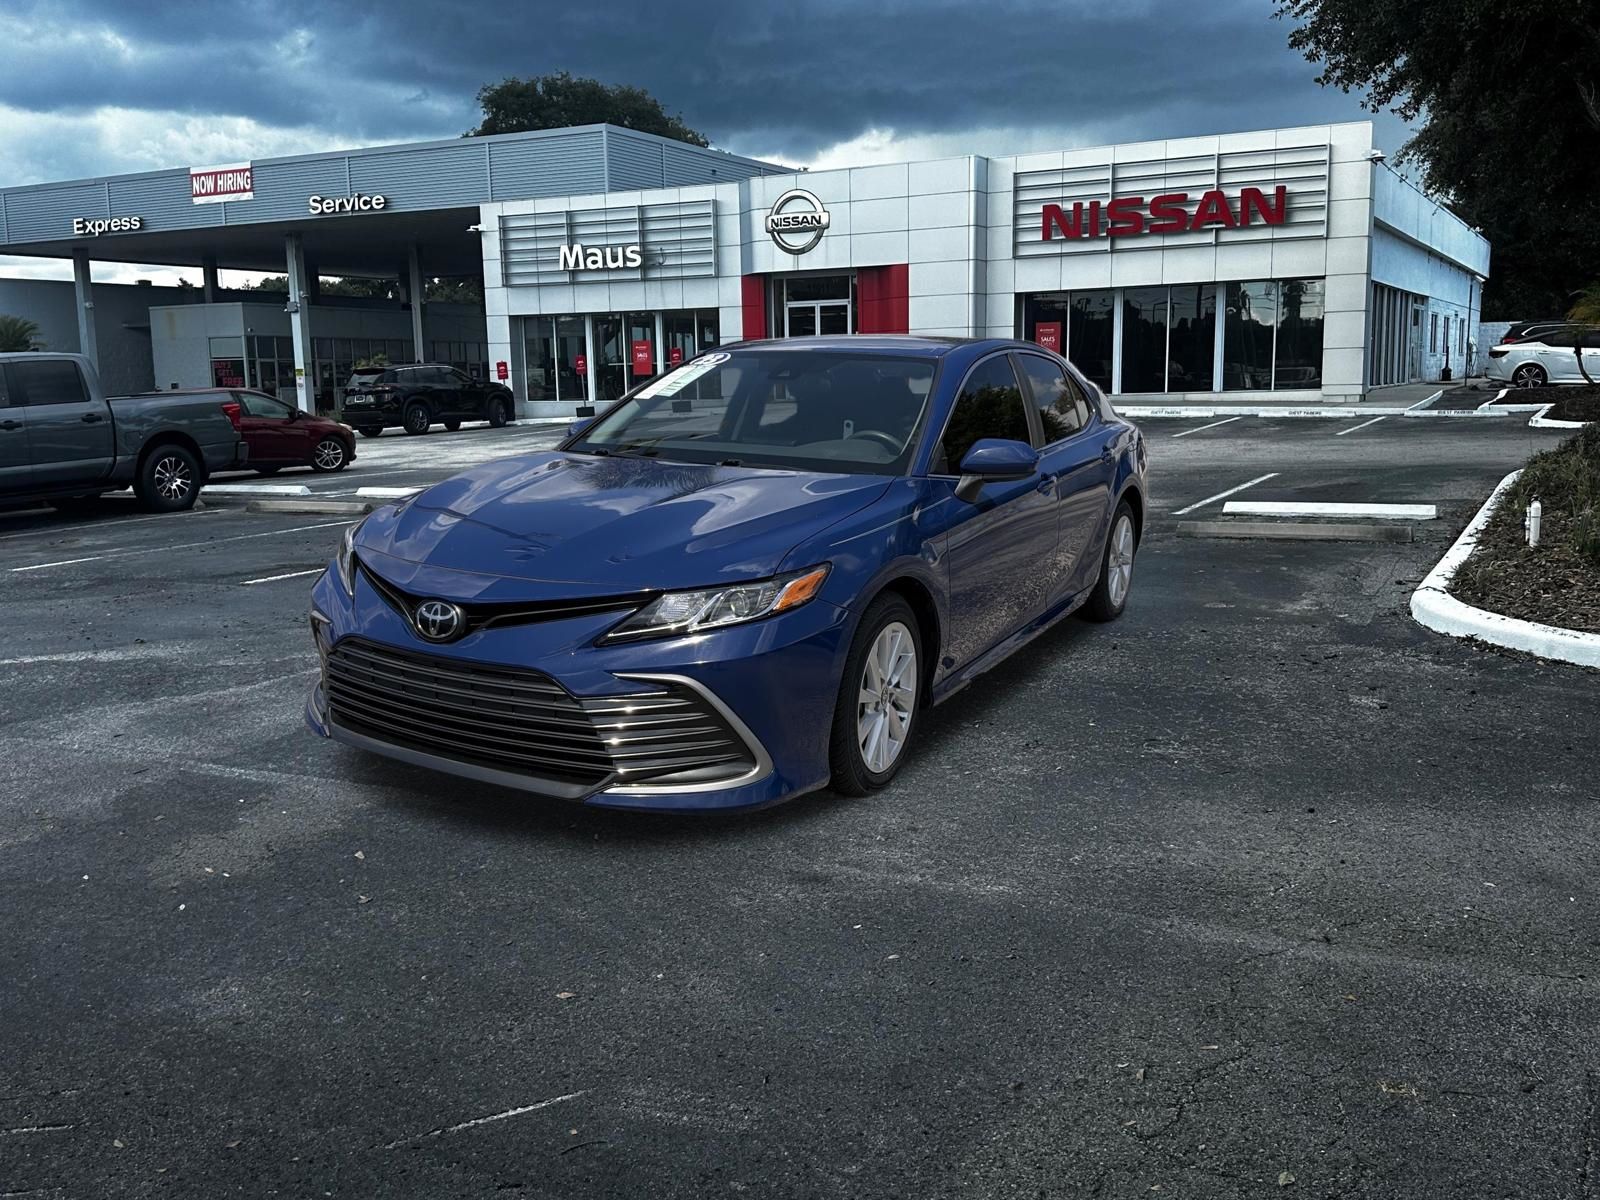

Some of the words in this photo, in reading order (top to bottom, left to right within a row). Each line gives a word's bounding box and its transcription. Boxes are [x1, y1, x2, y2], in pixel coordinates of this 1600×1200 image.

[192, 174, 215, 195] NOW
[217, 171, 251, 192] HIRING
[309, 193, 385, 214] Service
[1041, 185, 1286, 241] NISSAN
[73, 216, 141, 236] Express
[770, 215, 822, 228] NISSAN
[559, 243, 642, 271] Maus
